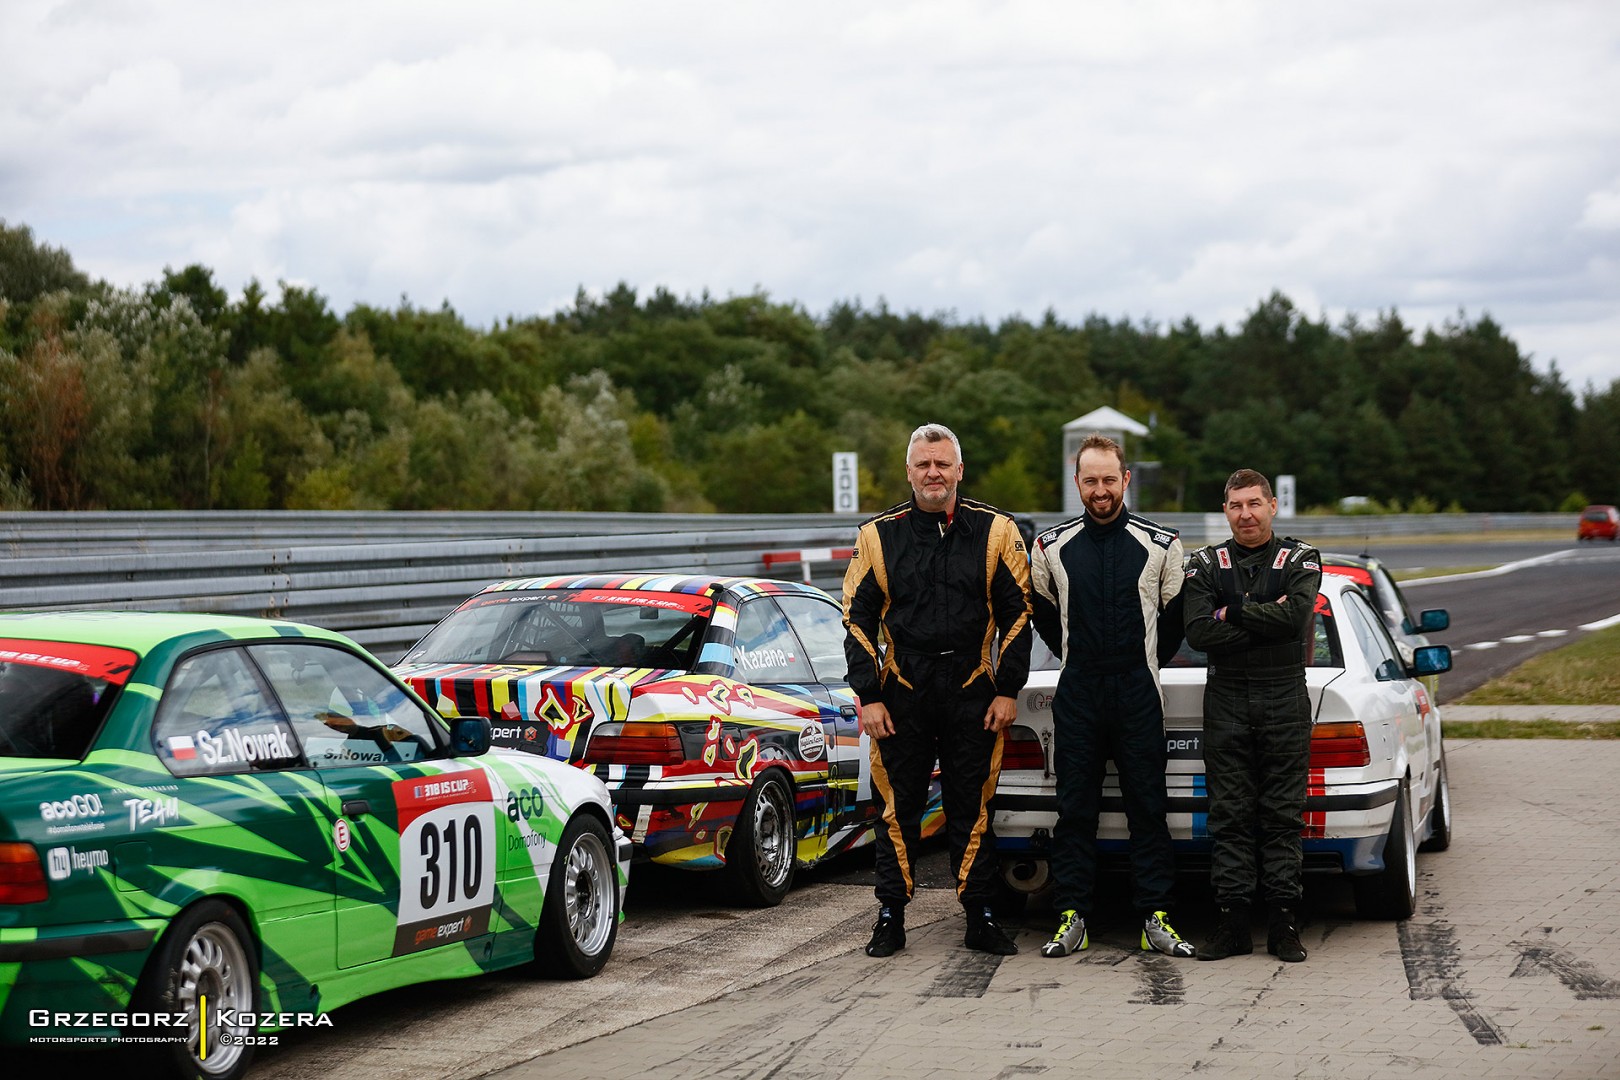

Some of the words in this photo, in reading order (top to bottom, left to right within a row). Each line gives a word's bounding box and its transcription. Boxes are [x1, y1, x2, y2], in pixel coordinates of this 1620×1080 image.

[735, 645, 788, 670] Kazana
[197, 725, 293, 765] Sz.Nowak
[1167, 737, 1200, 752] pert
[39, 793, 105, 821] acoGO!
[123, 797, 179, 832] TEAM
[507, 786, 544, 823] aco
[338, 826, 346, 844] E
[508, 829, 547, 851] Domofony
[71, 846, 109, 875] heymo
[420, 814, 482, 909] 310
